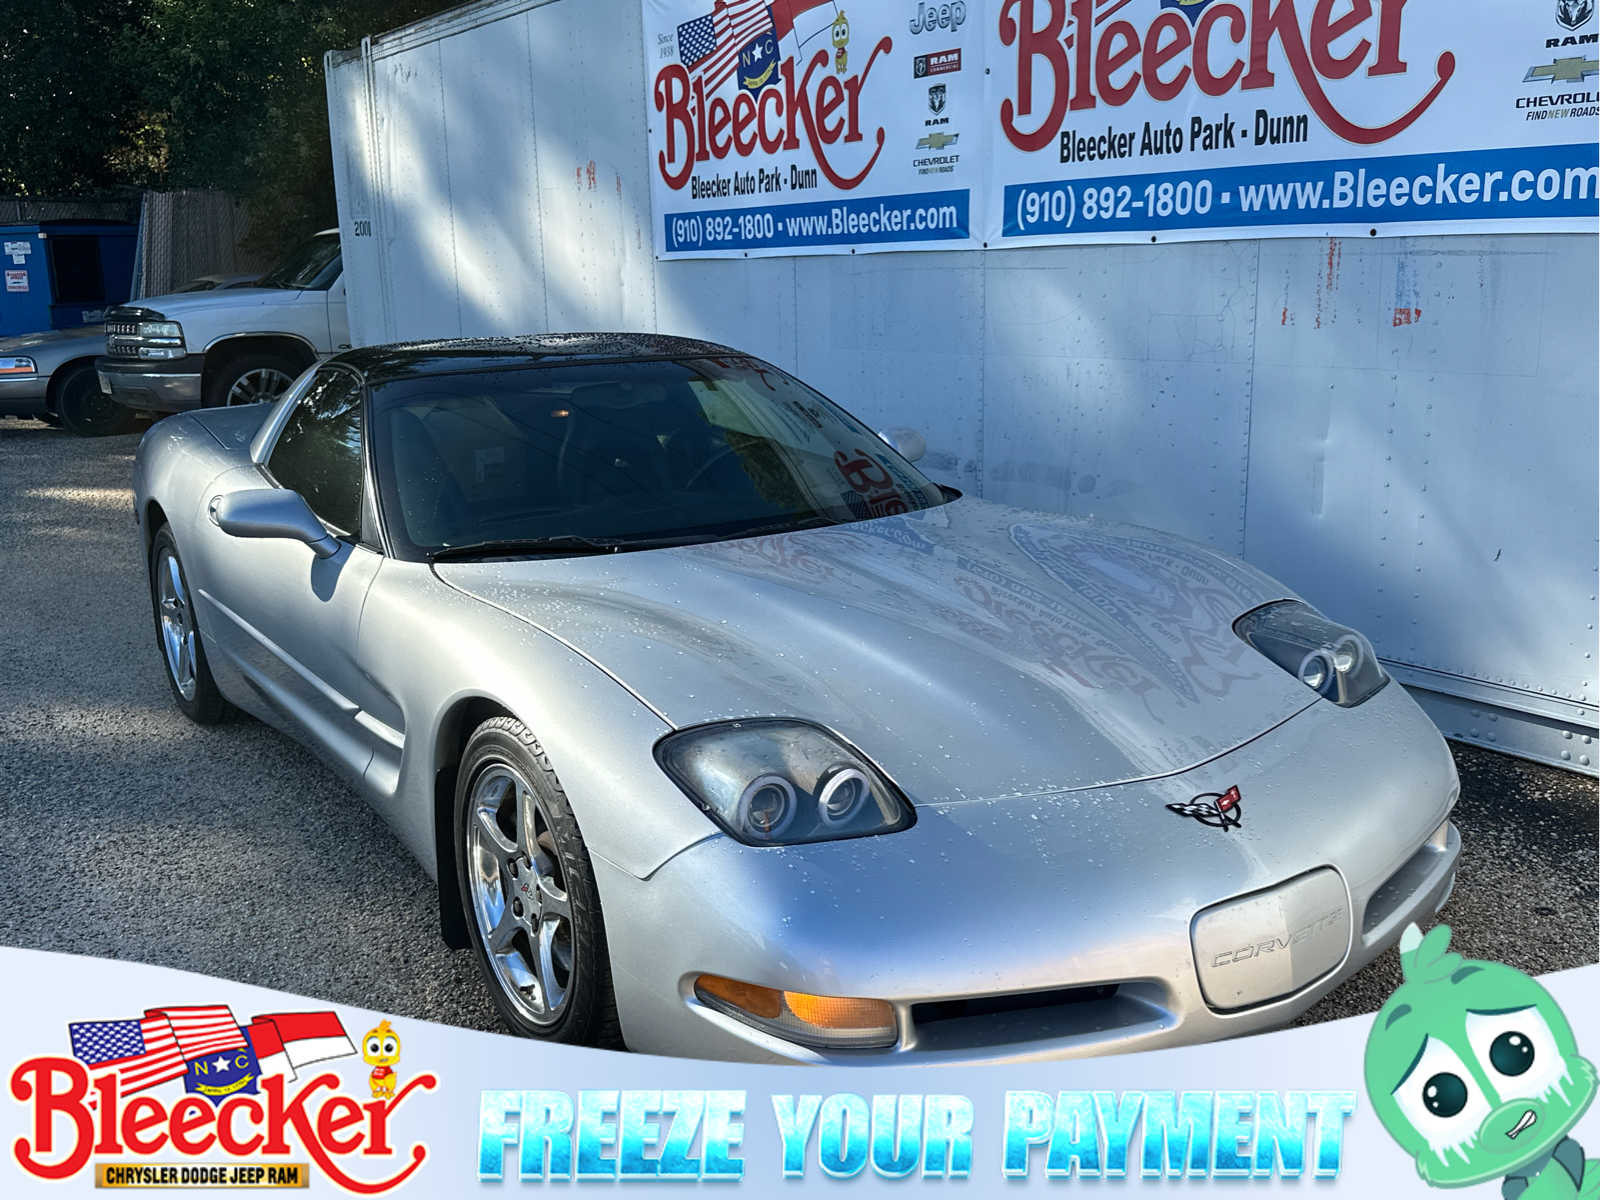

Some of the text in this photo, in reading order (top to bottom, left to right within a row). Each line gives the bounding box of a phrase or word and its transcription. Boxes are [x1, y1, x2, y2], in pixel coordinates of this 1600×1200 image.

[909, 1, 967, 35] Jeep
[1546, 34, 1599, 48] RAM
[930, 53, 959, 66] RAM
[654, 36, 893, 191] Bleecker
[925, 117, 949, 126] RAM
[1059, 109, 1309, 163] Bleecker Auto Park Dunn
[913, 155, 960, 168] CHEVROLET
[691, 164, 818, 200] Bleecker Auto Park Dunn
[1016, 163, 1599, 231] (910) 892-1800 www.Bleecker.com
[671, 203, 958, 248] (910) 892-1800 www.Bleecker.com
[1211, 908, 1346, 968] CORVETTE
